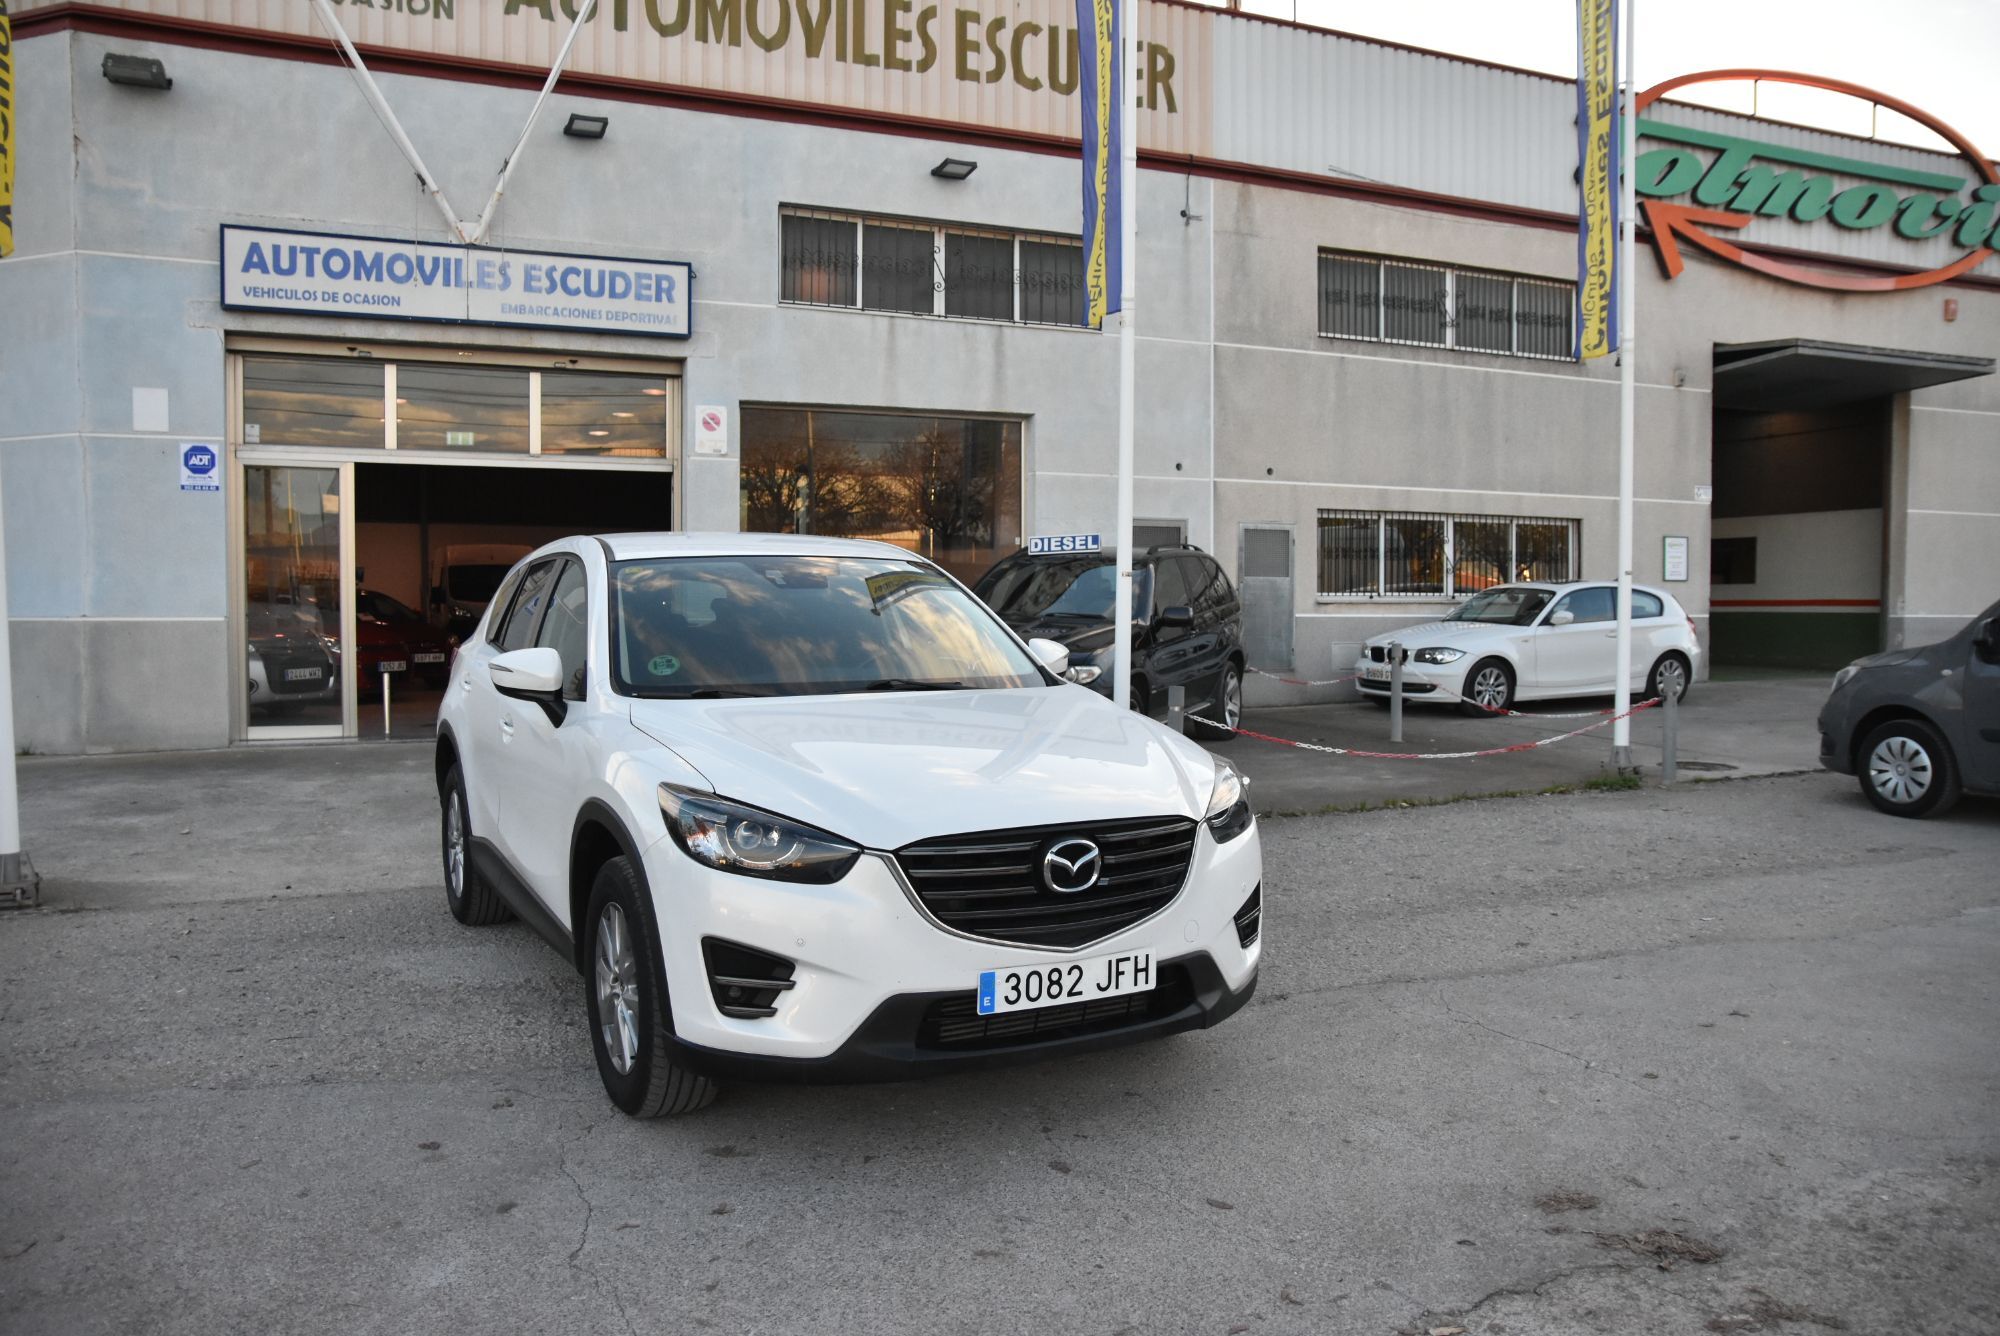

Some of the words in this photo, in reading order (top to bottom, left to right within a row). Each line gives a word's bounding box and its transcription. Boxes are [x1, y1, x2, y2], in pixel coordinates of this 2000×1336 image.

[955, 9, 1177, 114] ESCUER
[241, 242, 512, 292] AUTOMOVILES
[523, 263, 677, 304] ESCUDER
[243, 286, 318, 302] VEHICULOS
[321, 291, 339, 304] DE
[342, 292, 401, 307] OCASION
[501, 302, 602, 320] EMBARCACIONES
[189, 455, 210, 466] ADT
[1030, 535, 1098, 552] DIESEL
[984, 997, 991, 1006] E
[1004, 965, 1083, 1005] 3082
[1096, 953, 1150, 992] JFH
